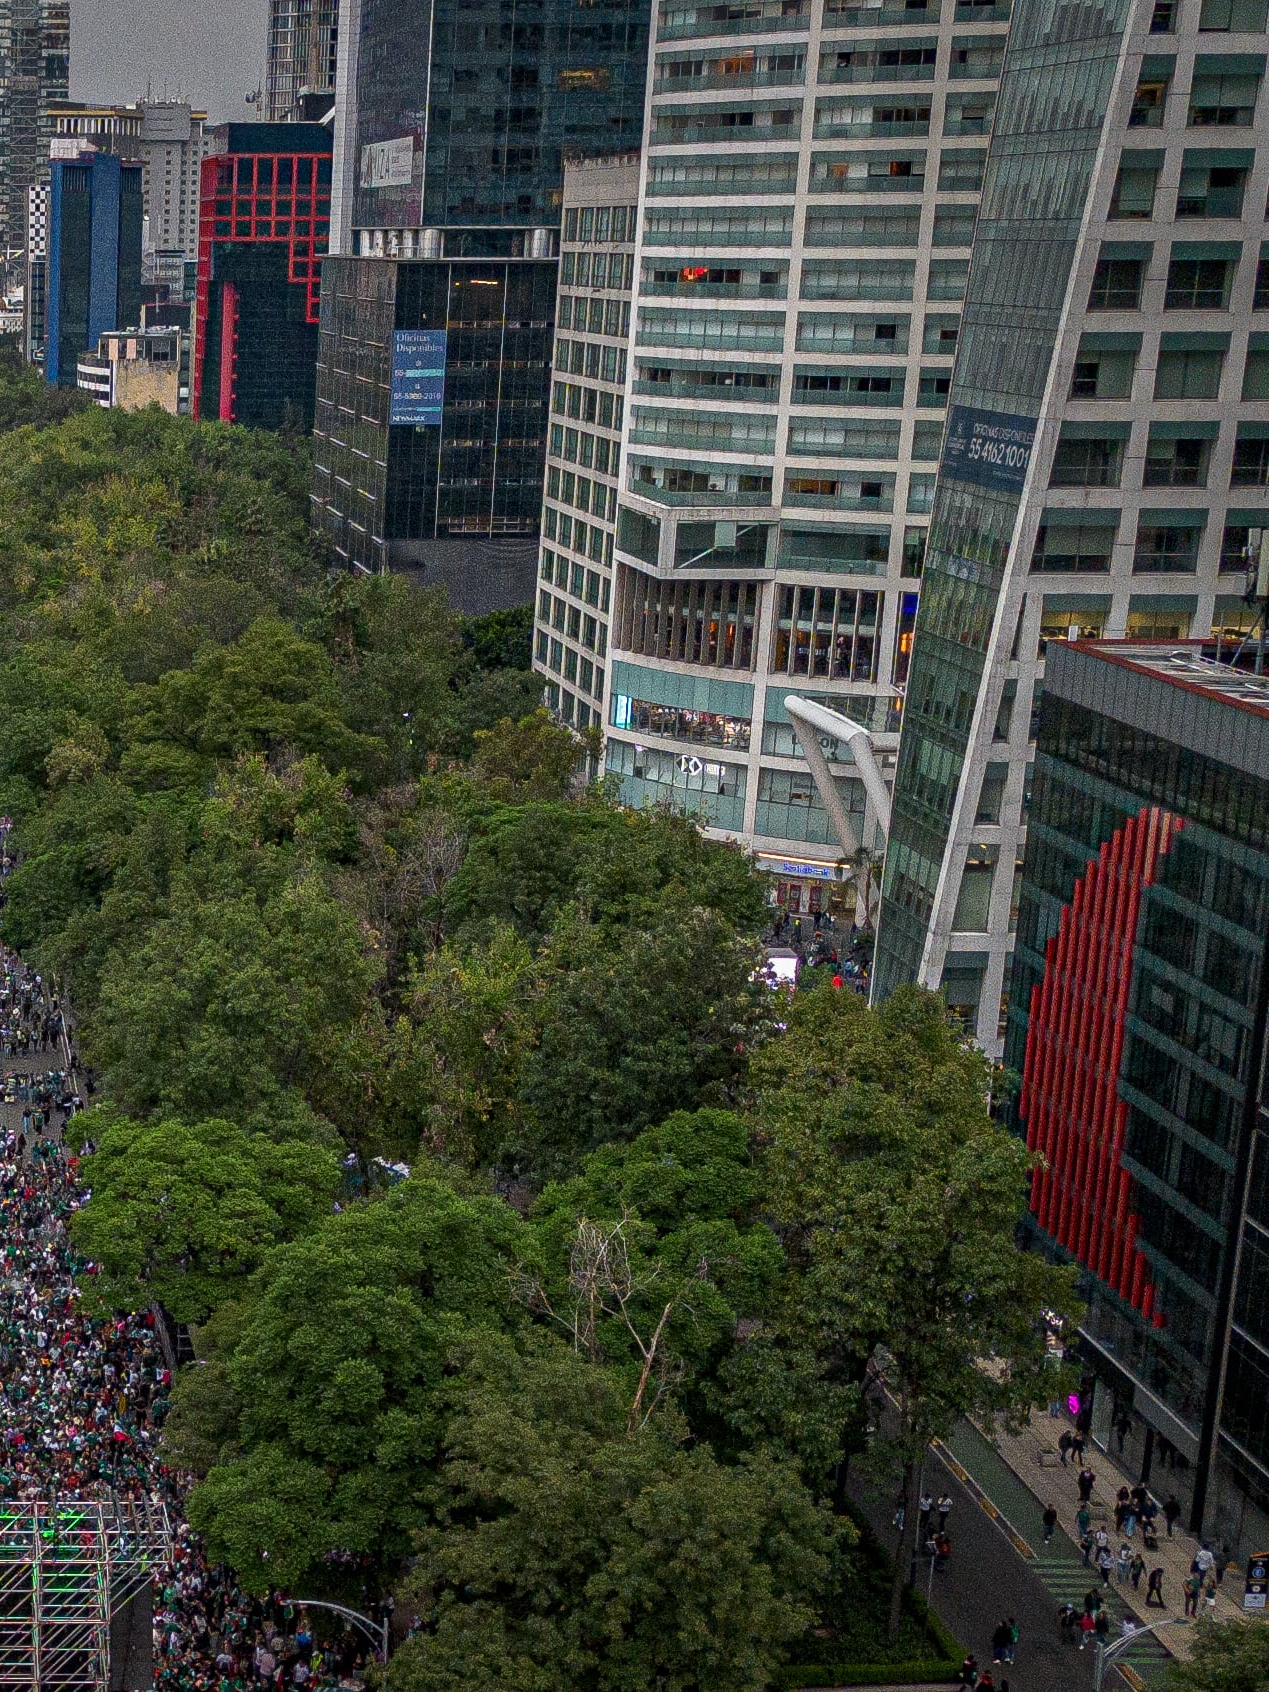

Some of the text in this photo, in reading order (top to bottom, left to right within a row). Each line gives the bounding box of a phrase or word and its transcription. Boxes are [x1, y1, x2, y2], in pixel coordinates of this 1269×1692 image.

[396, 333, 430, 342] Oficinas
[396, 343, 444, 354] Disponibles
[968, 437, 983, 460] 55
[981, 440, 1005, 464] 4162
[1004, 444, 1030, 469] 1001
[783, 863, 829, 877] Scotiabank
